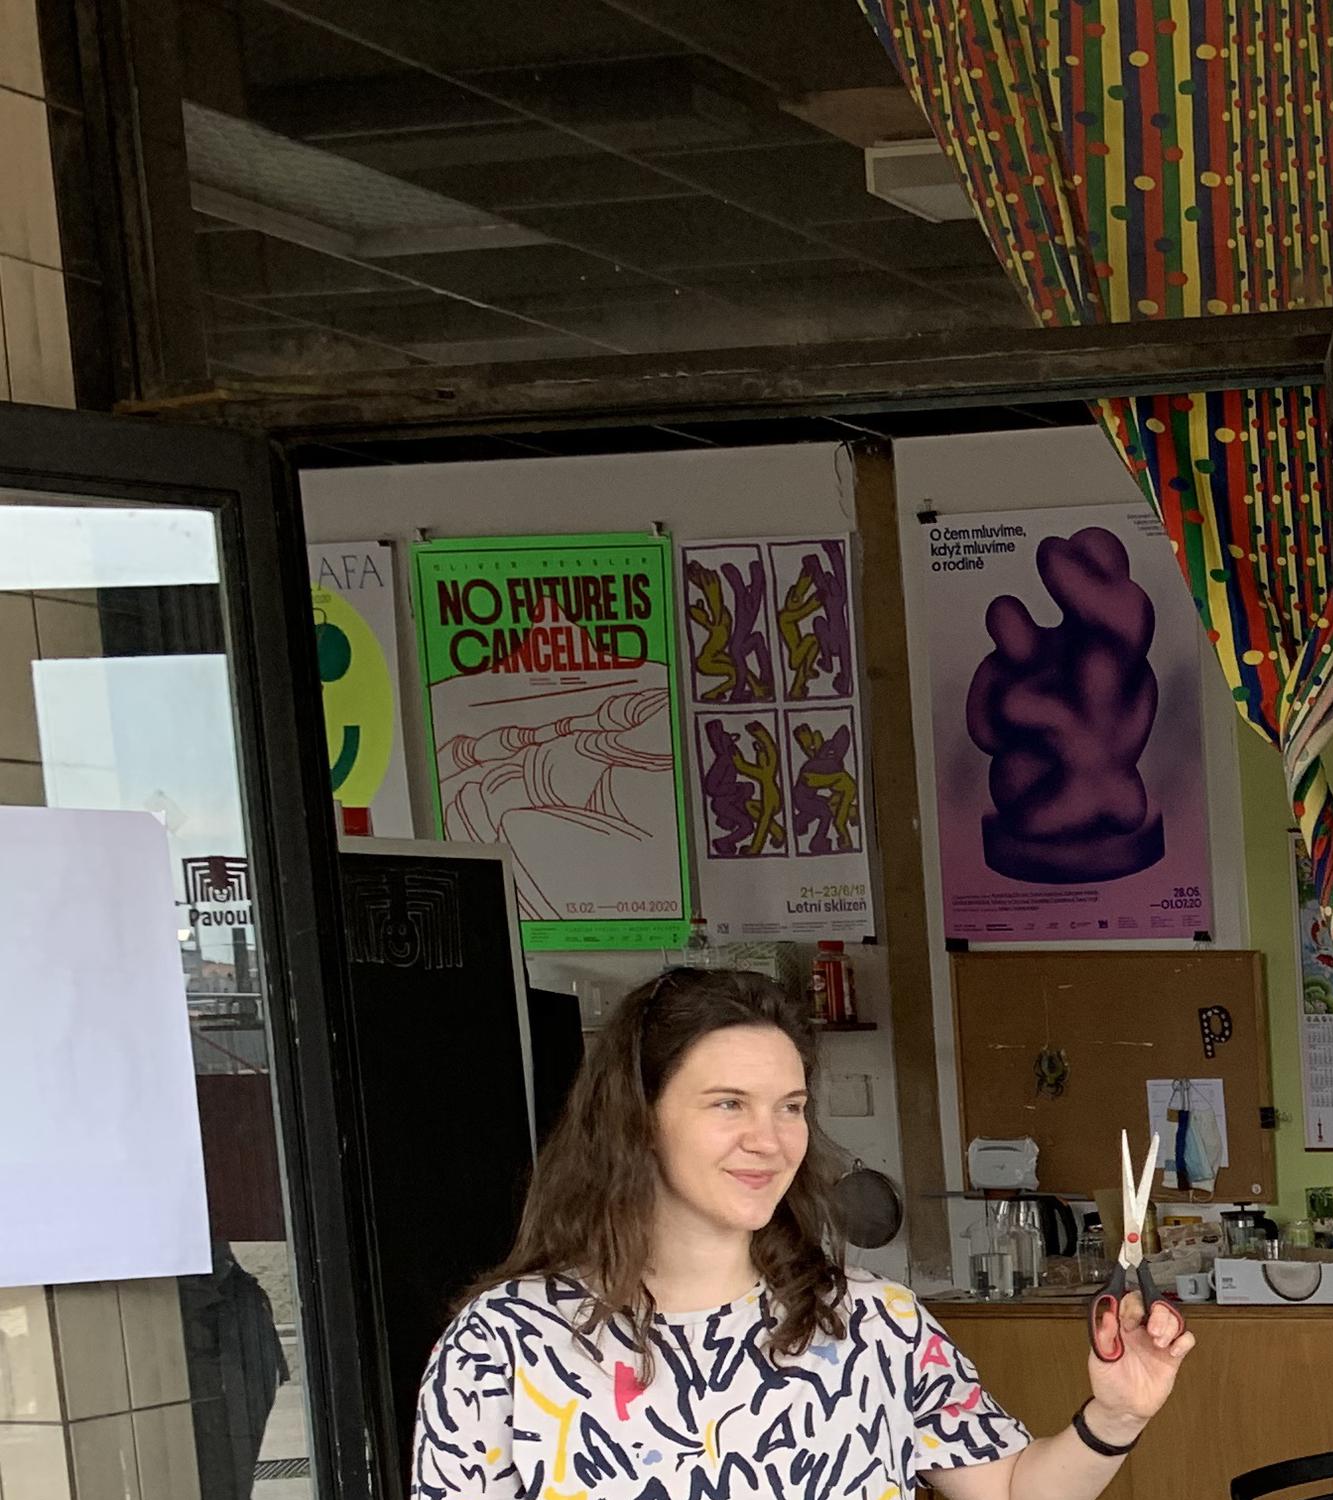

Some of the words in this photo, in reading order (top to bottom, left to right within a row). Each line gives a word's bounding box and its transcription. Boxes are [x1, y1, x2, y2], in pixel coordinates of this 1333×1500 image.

[943, 525, 970, 541] čem
[972, 523, 1027, 539] mluvíme,
[931, 542, 962, 557] když
[963, 540, 1016, 555] mluvíme
[433, 561, 517, 571] OLIVER
[931, 561, 942, 572] o
[943, 556, 985, 571] rodině
[437, 578, 503, 626] NO
[506, 574, 618, 624] FUTURE
[622, 573, 652, 620] IS
[449, 623, 649, 675] CANCELLED
[787, 900, 822, 914] Letní
[824, 897, 867, 912] sklizeň
